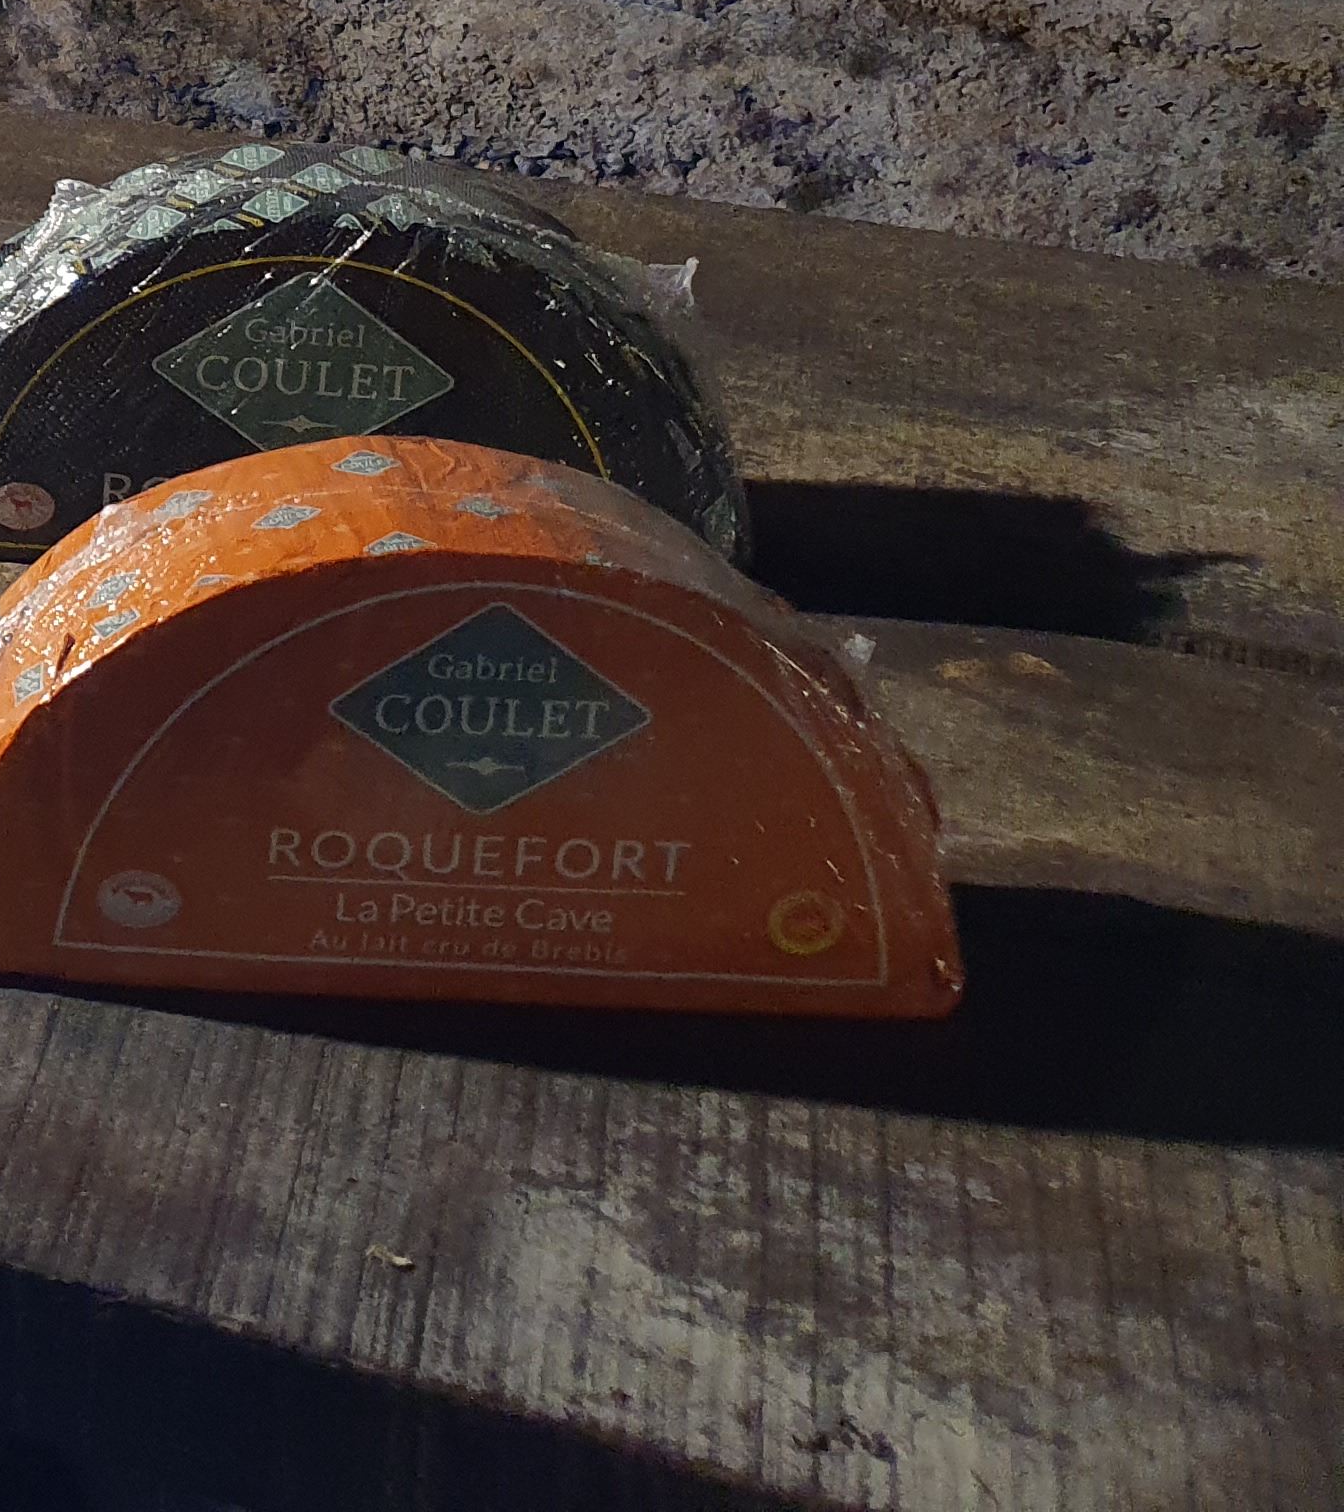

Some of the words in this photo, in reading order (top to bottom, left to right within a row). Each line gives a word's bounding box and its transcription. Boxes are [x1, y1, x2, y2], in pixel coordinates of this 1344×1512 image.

[244, 317, 365, 349] Gabriel
[195, 354, 416, 402] COULET
[427, 653, 558, 684] Gabriel
[375, 693, 611, 739] COULET
[268, 827, 693, 884] ROQUEFORT
[335, 891, 379, 923] La
[389, 893, 506, 928] Petite
[516, 898, 614, 934] Cave
[308, 929, 349, 954] Au
[423, 936, 473, 957] cru
[482, 937, 519, 958] de
